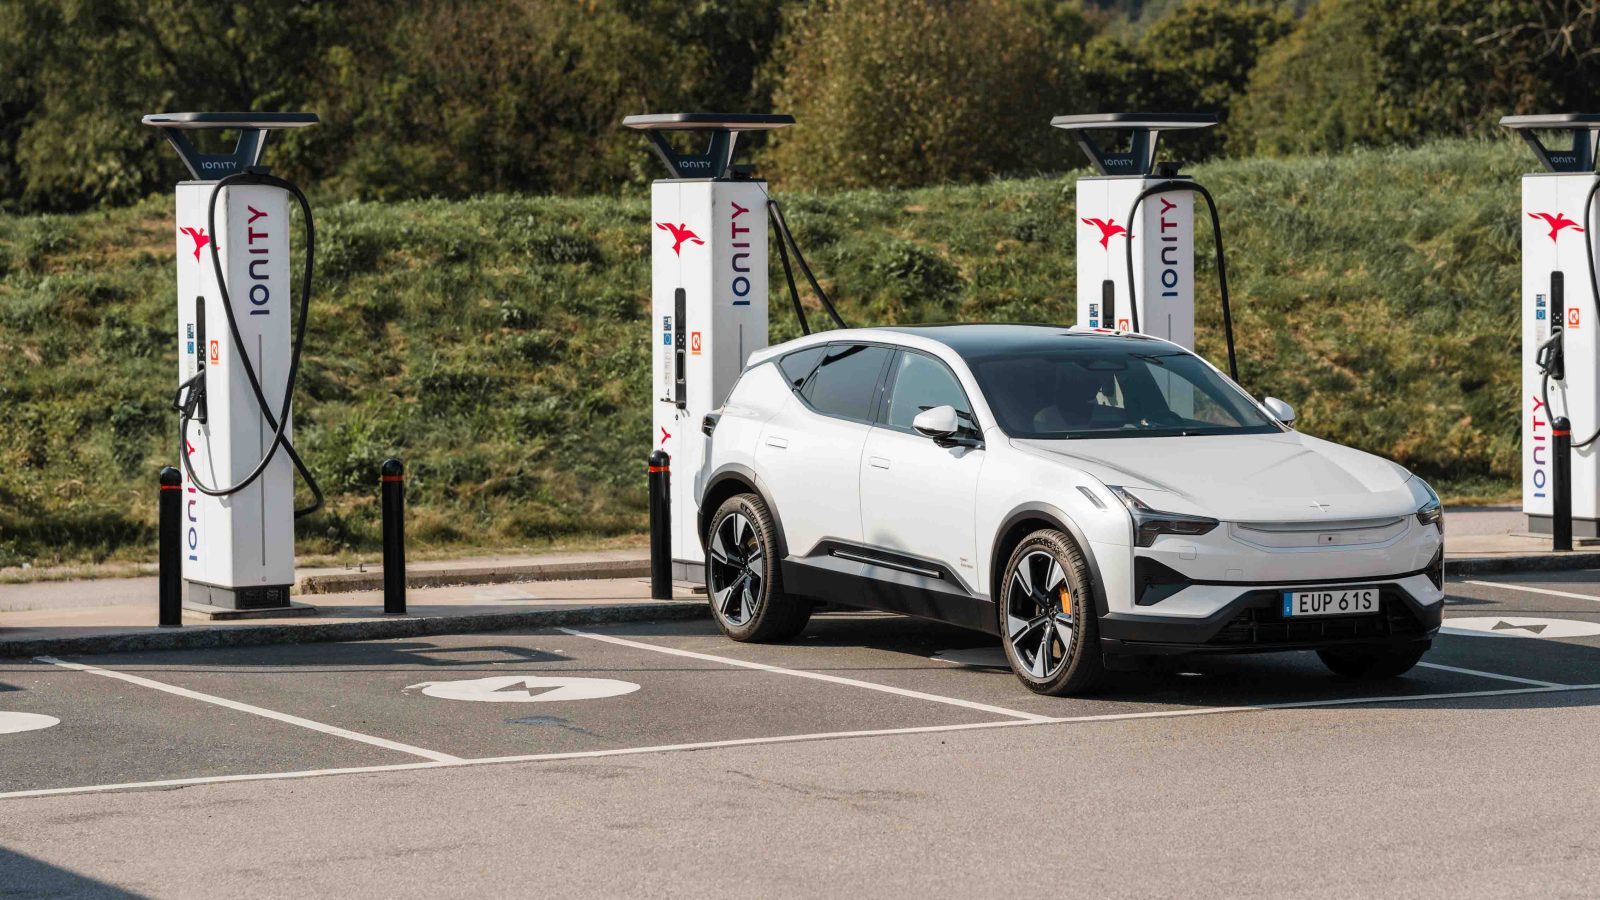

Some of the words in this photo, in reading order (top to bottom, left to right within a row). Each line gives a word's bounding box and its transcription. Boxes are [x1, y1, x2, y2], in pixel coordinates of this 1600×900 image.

[201, 160, 237, 170] IONITY
[678, 160, 711, 169] IONITY
[1104, 158, 1134, 167] IONITY
[1550, 156, 1576, 165] IONITY
[247, 204, 270, 316] IONITY
[731, 201, 750, 306] IONITY
[1160, 196, 1178, 297] IONITY
[1532, 395, 1546, 498] IONITY
[186, 439, 198, 562] IONIY
[1300, 593, 1333, 613] EUP
[1338, 591, 1372, 611] 61S
